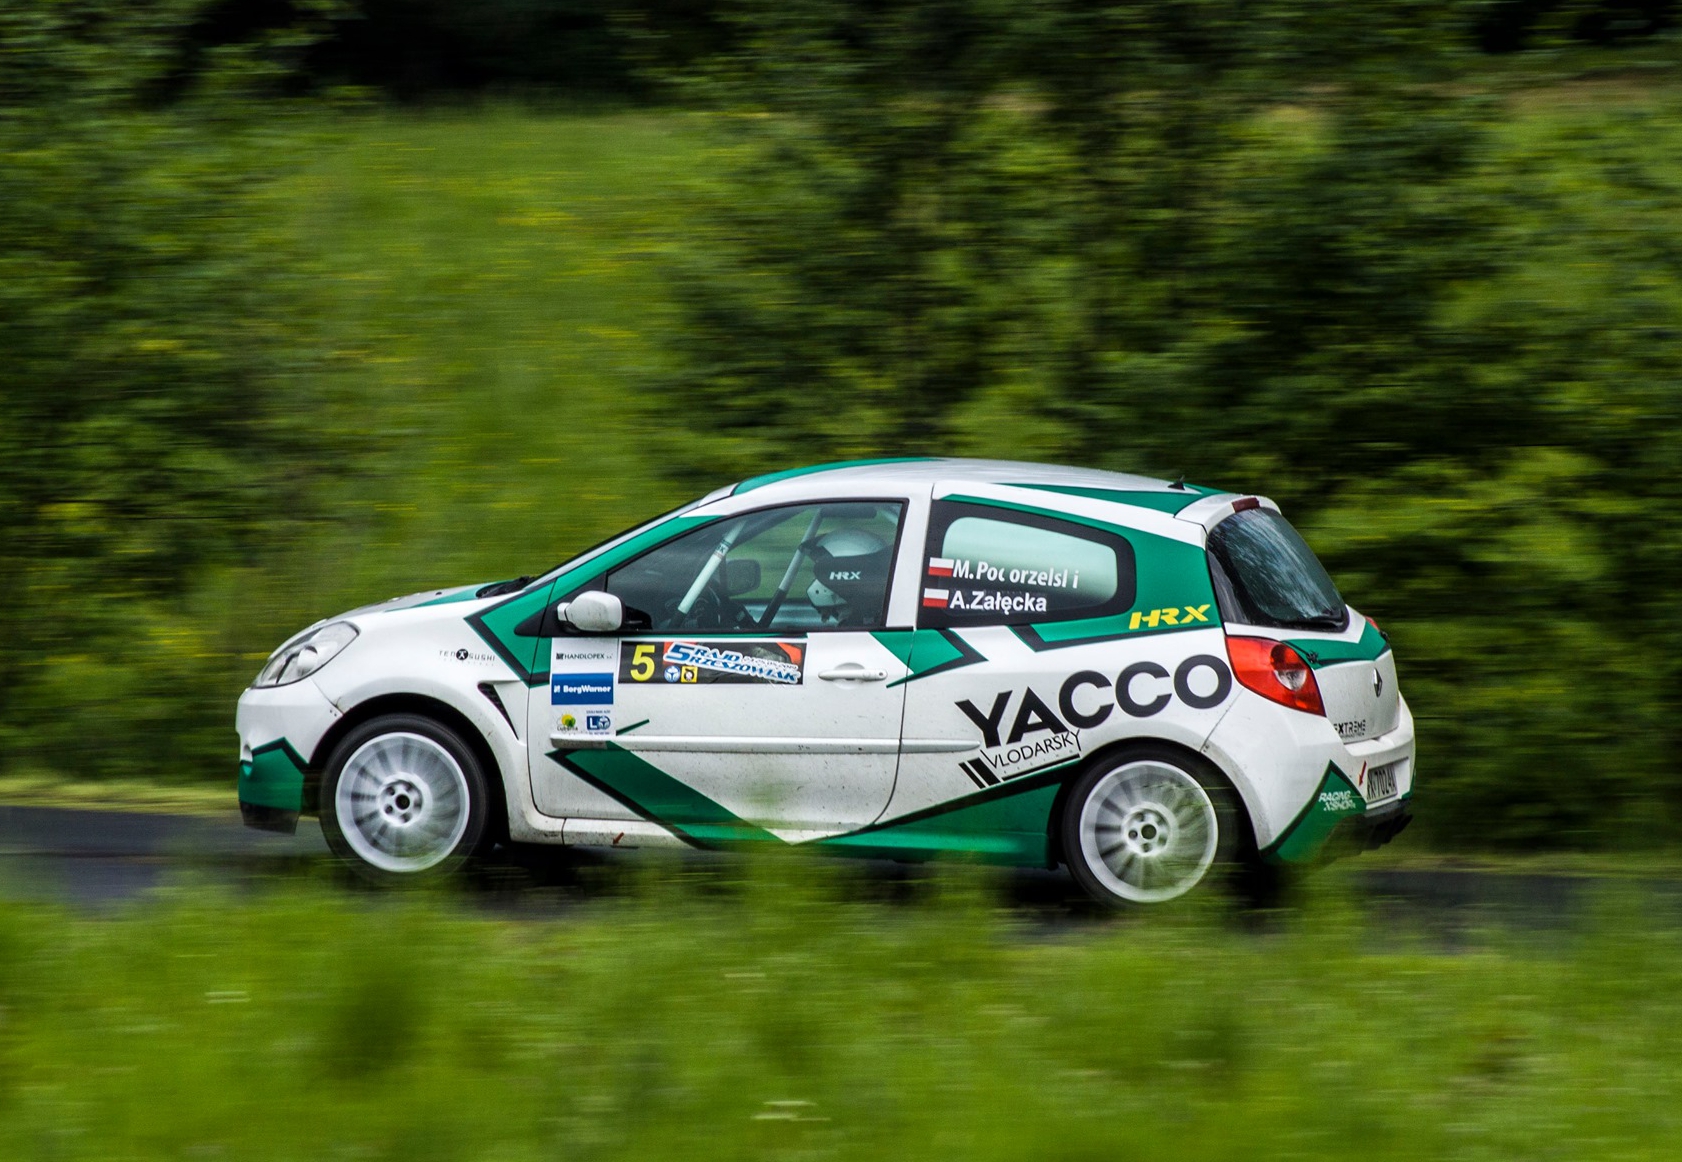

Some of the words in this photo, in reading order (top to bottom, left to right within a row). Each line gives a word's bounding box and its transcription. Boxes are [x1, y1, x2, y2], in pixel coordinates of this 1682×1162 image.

[829, 571, 861, 580] HRX
[950, 590, 1047, 615] A.Załęcka
[1129, 604, 1211, 629] HRX
[630, 644, 656, 682] 5
[563, 684, 611, 694] BorgWarner
[954, 654, 1233, 749] YACCO
[1333, 719, 1366, 734] EXTREME
[980, 729, 1081, 769] VLODARSKY
